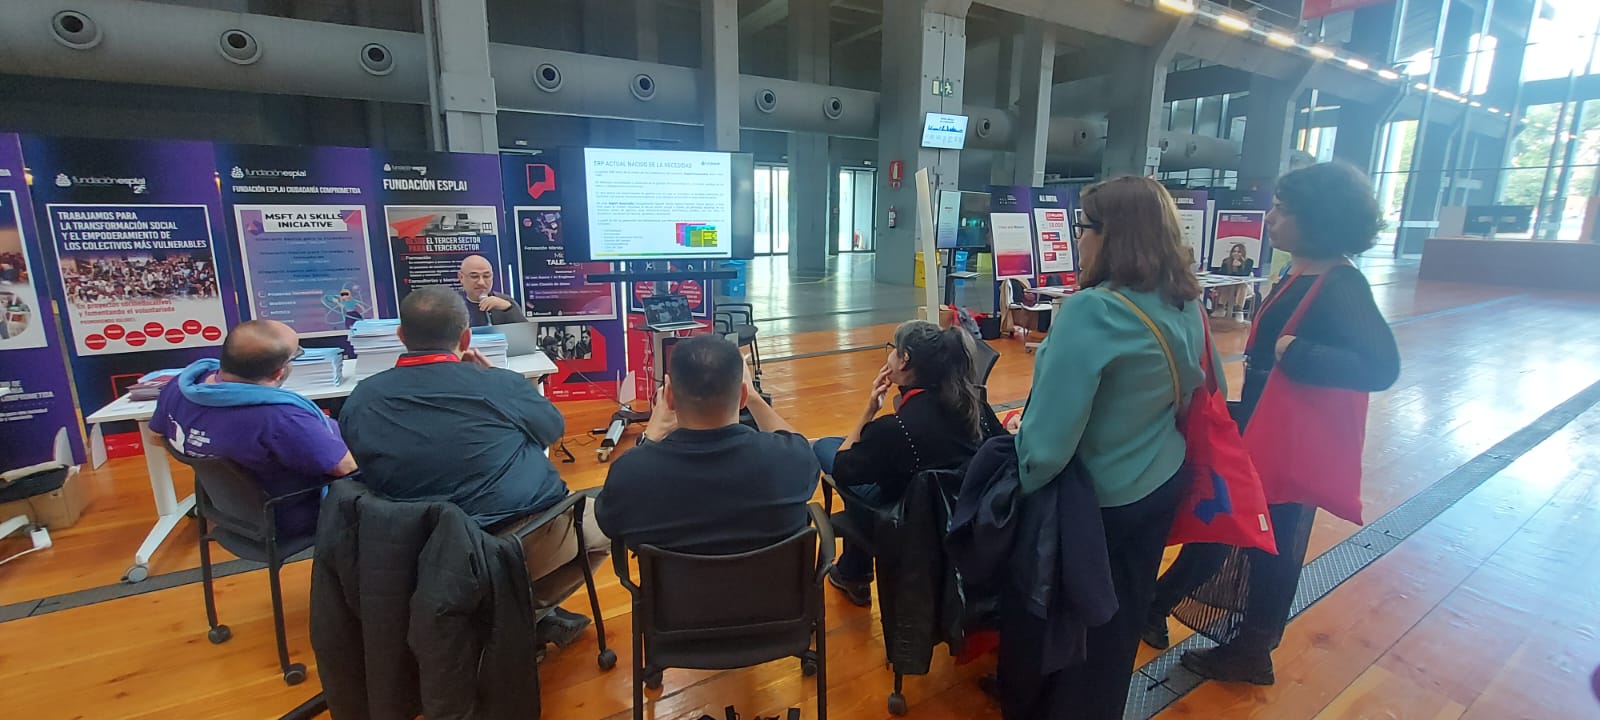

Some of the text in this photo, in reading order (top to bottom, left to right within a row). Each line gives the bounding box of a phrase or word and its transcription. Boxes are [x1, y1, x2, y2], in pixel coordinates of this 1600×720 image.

[232, 185, 265, 193] FUNDACIÓN
[383, 178, 467, 191] FUNDACIÓN ESPLAI
[57, 211, 138, 220] TRABAJAMOS PARA
[60, 221, 178, 230] LA TRANSFORMACIÓN SOCIAL
[62, 231, 171, 240] Y EL EMPODERAMIENTO DE
[64, 240, 207, 250] LOS COLECTIVOS MÁS VULNERABLES
[426, 244, 434, 252] EL
